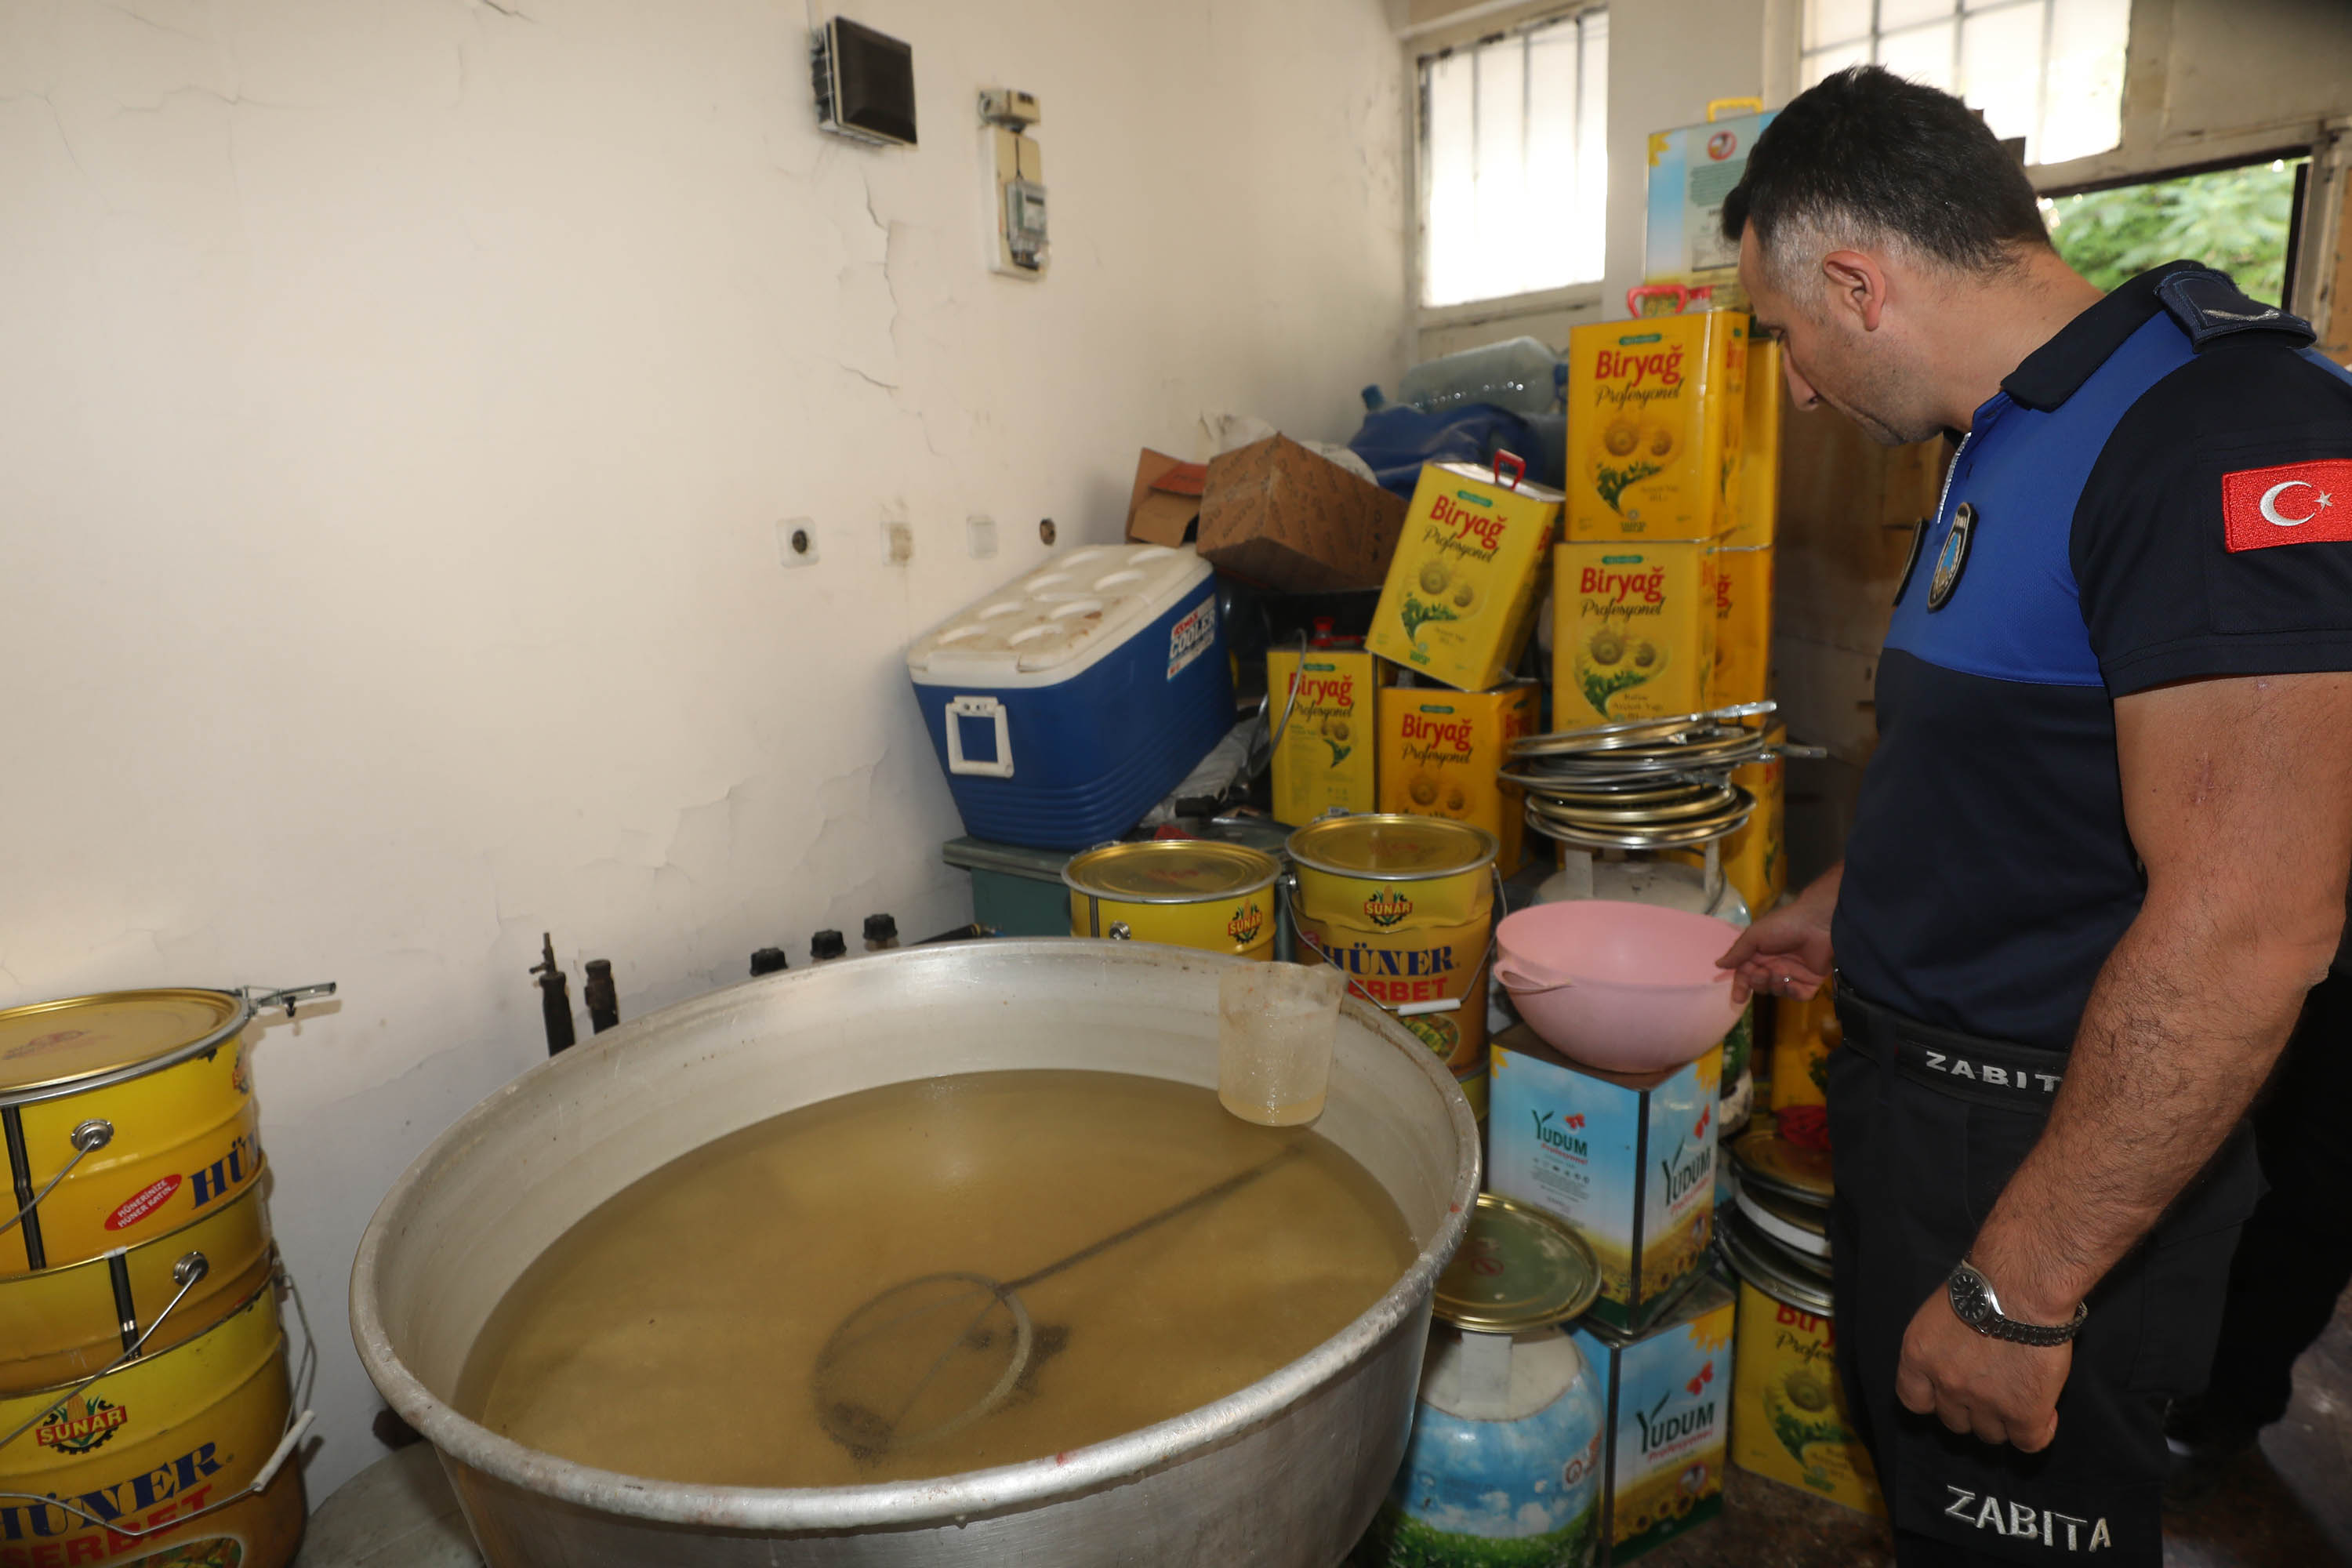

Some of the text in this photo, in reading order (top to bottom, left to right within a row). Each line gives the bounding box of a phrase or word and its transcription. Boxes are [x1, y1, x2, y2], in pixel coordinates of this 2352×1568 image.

[1594, 343, 1685, 387] Biryağ
[1595, 377, 1686, 411] Profesyonel
[1429, 495, 1508, 550] Biryağ
[1579, 565, 1665, 603] Biryağ
[1580, 597, 1667, 624] Profesyonel
[1401, 714, 1473, 751] Biryağ
[1367, 903, 1410, 914] SUNAR
[1323, 942, 1454, 976] HÜNER
[1348, 978, 1449, 1001] ERBET
[1926, 1051, 2063, 1092] ZABIT
[188, 1132, 258, 1210] HÜN
[118, 1205, 149, 1228] HÜNER
[1777, 1305, 1835, 1348] Biry
[39, 1410, 124, 1444] SUNAR
[1636, 1390, 1715, 1454] YUDUM
[1944, 1485, 2112, 1553] ZABITA
